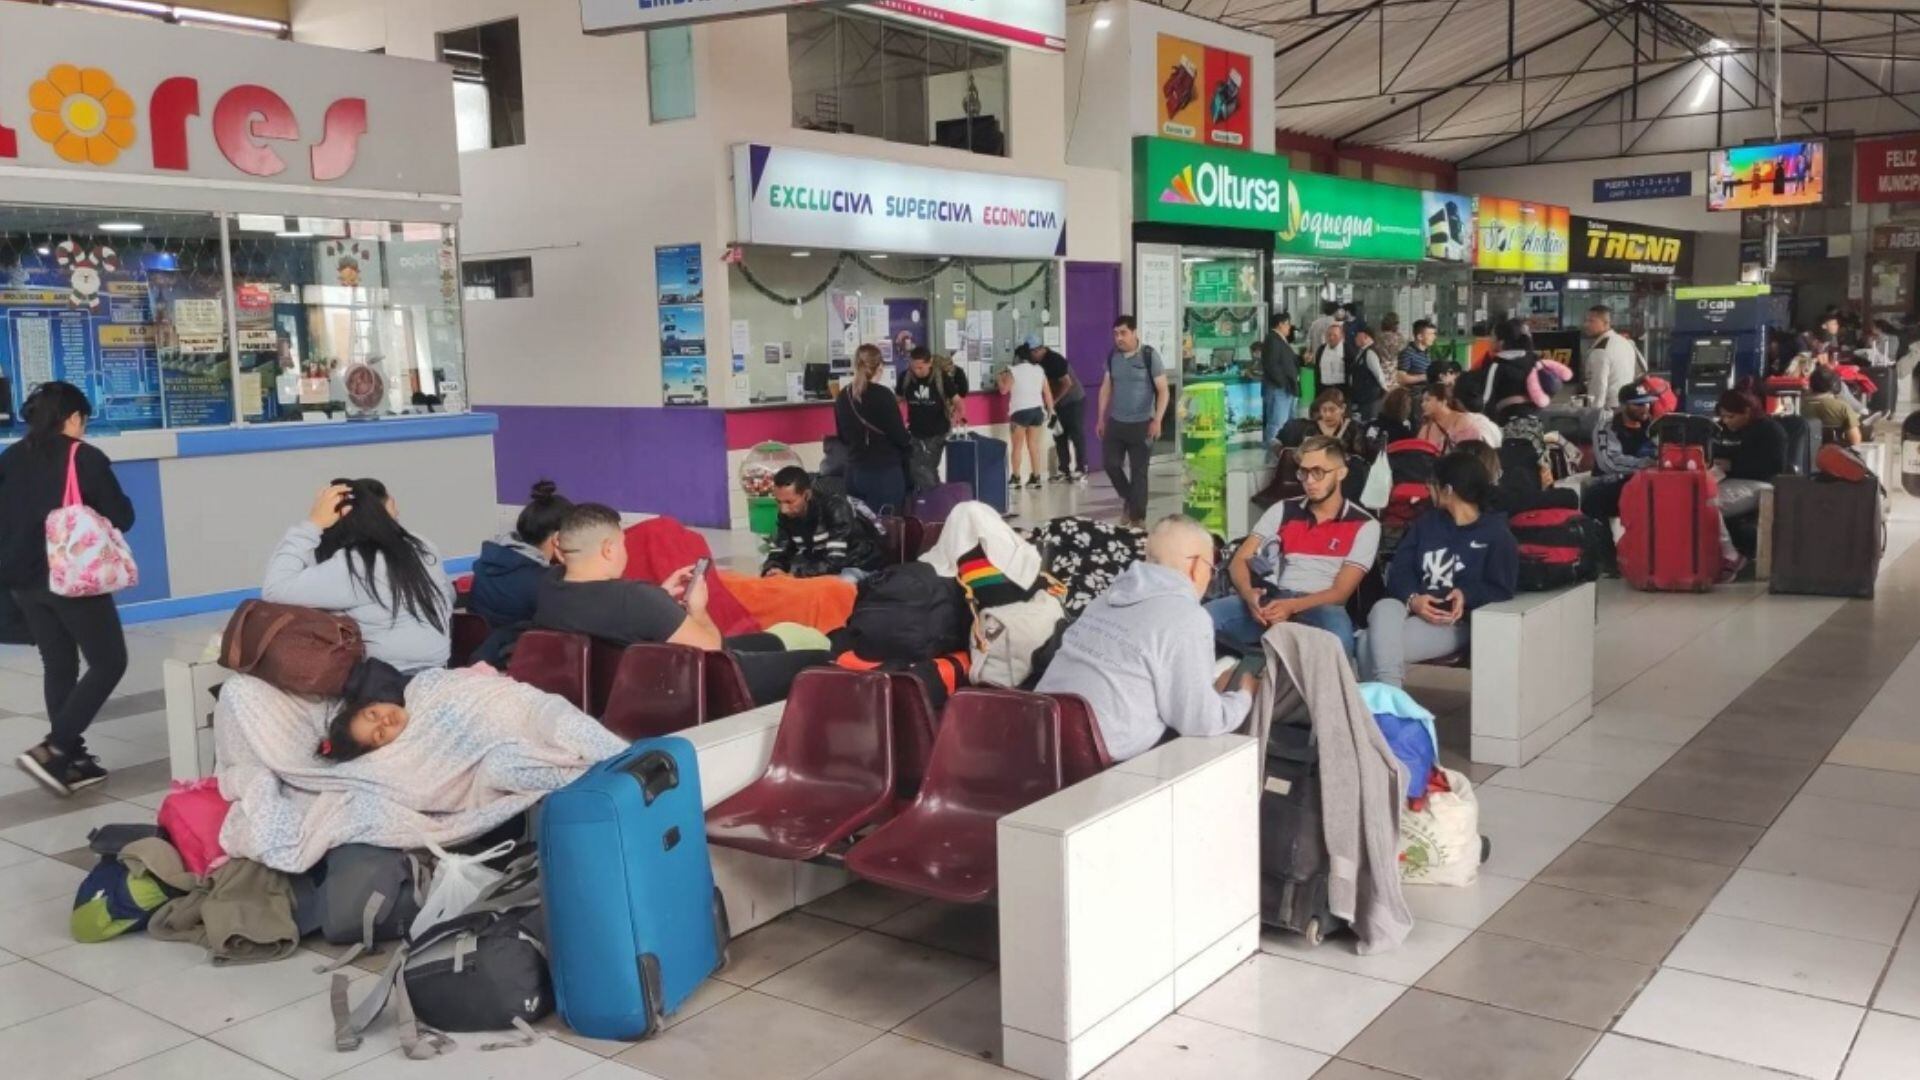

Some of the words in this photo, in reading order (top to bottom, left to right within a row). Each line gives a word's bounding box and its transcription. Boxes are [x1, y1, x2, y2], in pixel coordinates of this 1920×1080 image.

[1886, 150, 1918, 168] FELIZ
[1196, 161, 1281, 213] Oltursa
[769, 184, 873, 215] EXCLUCIVA
[885, 195, 973, 224] SUPERCIVA
[982, 205, 1057, 229] ECONOCIVA
[1586, 229, 1681, 263] TACNA
[1529, 280, 1554, 291] ICA
